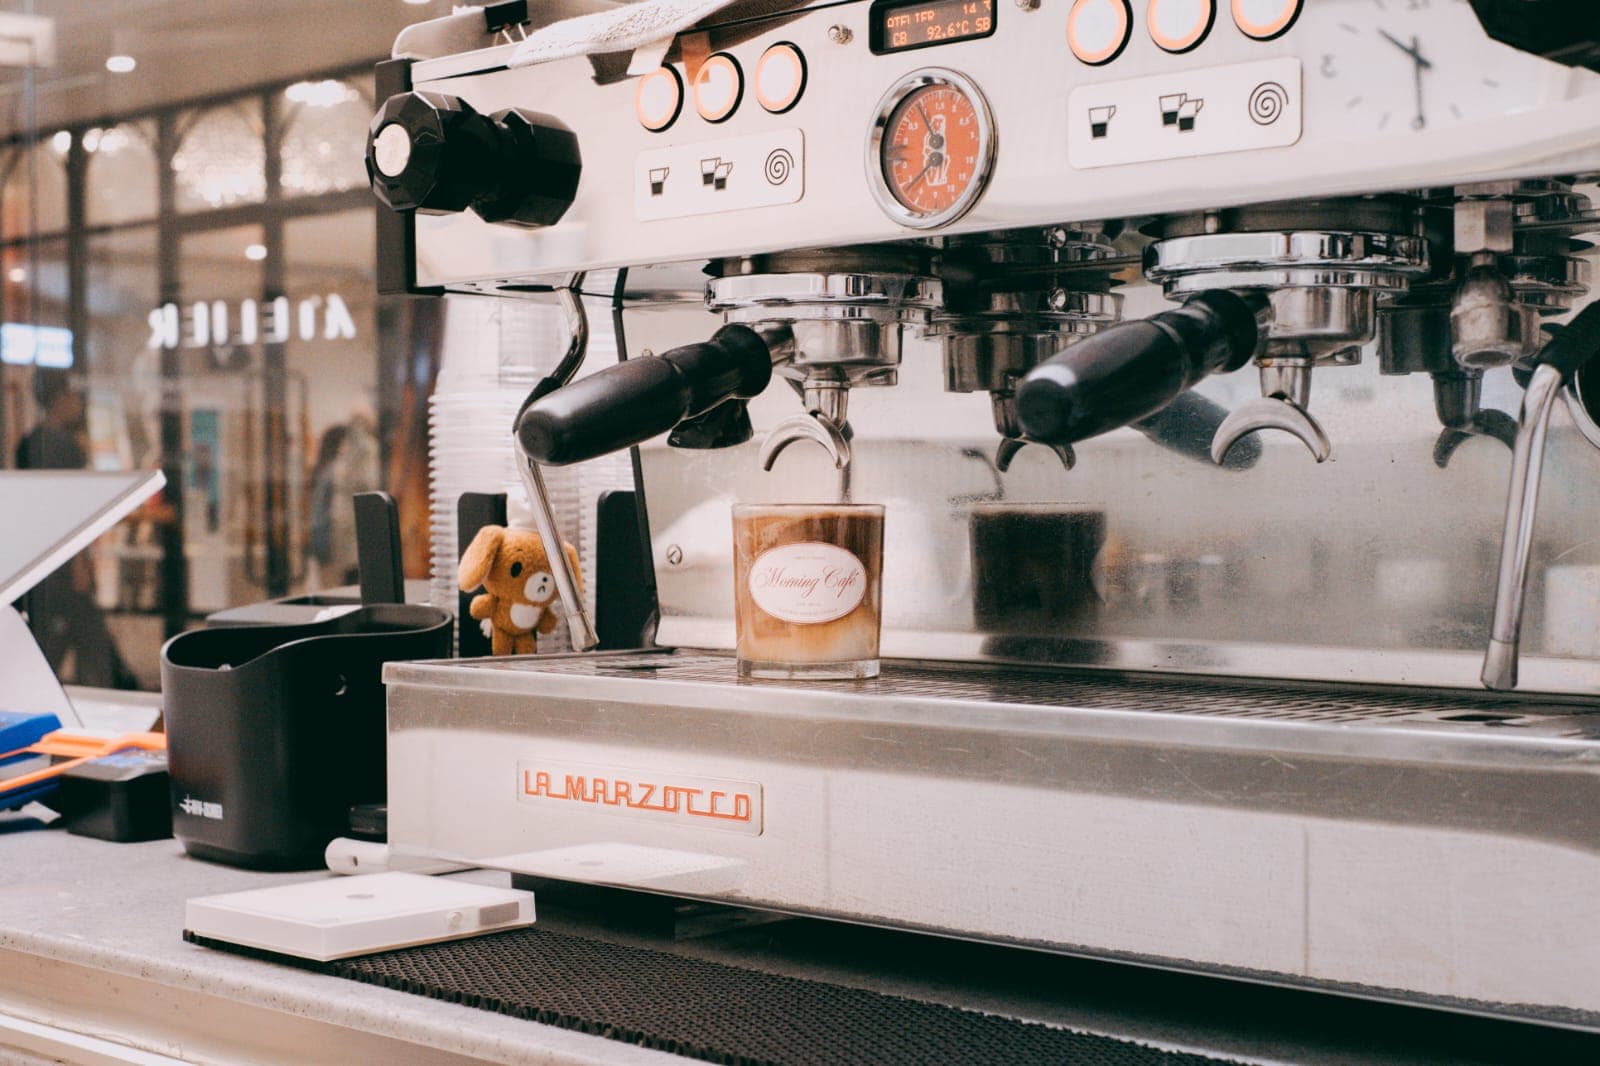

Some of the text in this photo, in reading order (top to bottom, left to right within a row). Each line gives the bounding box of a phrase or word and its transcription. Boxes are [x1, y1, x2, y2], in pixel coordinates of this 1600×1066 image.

[755, 565, 860, 599] Morning Café
[525, 770, 751, 822] LA MARZOCCO
